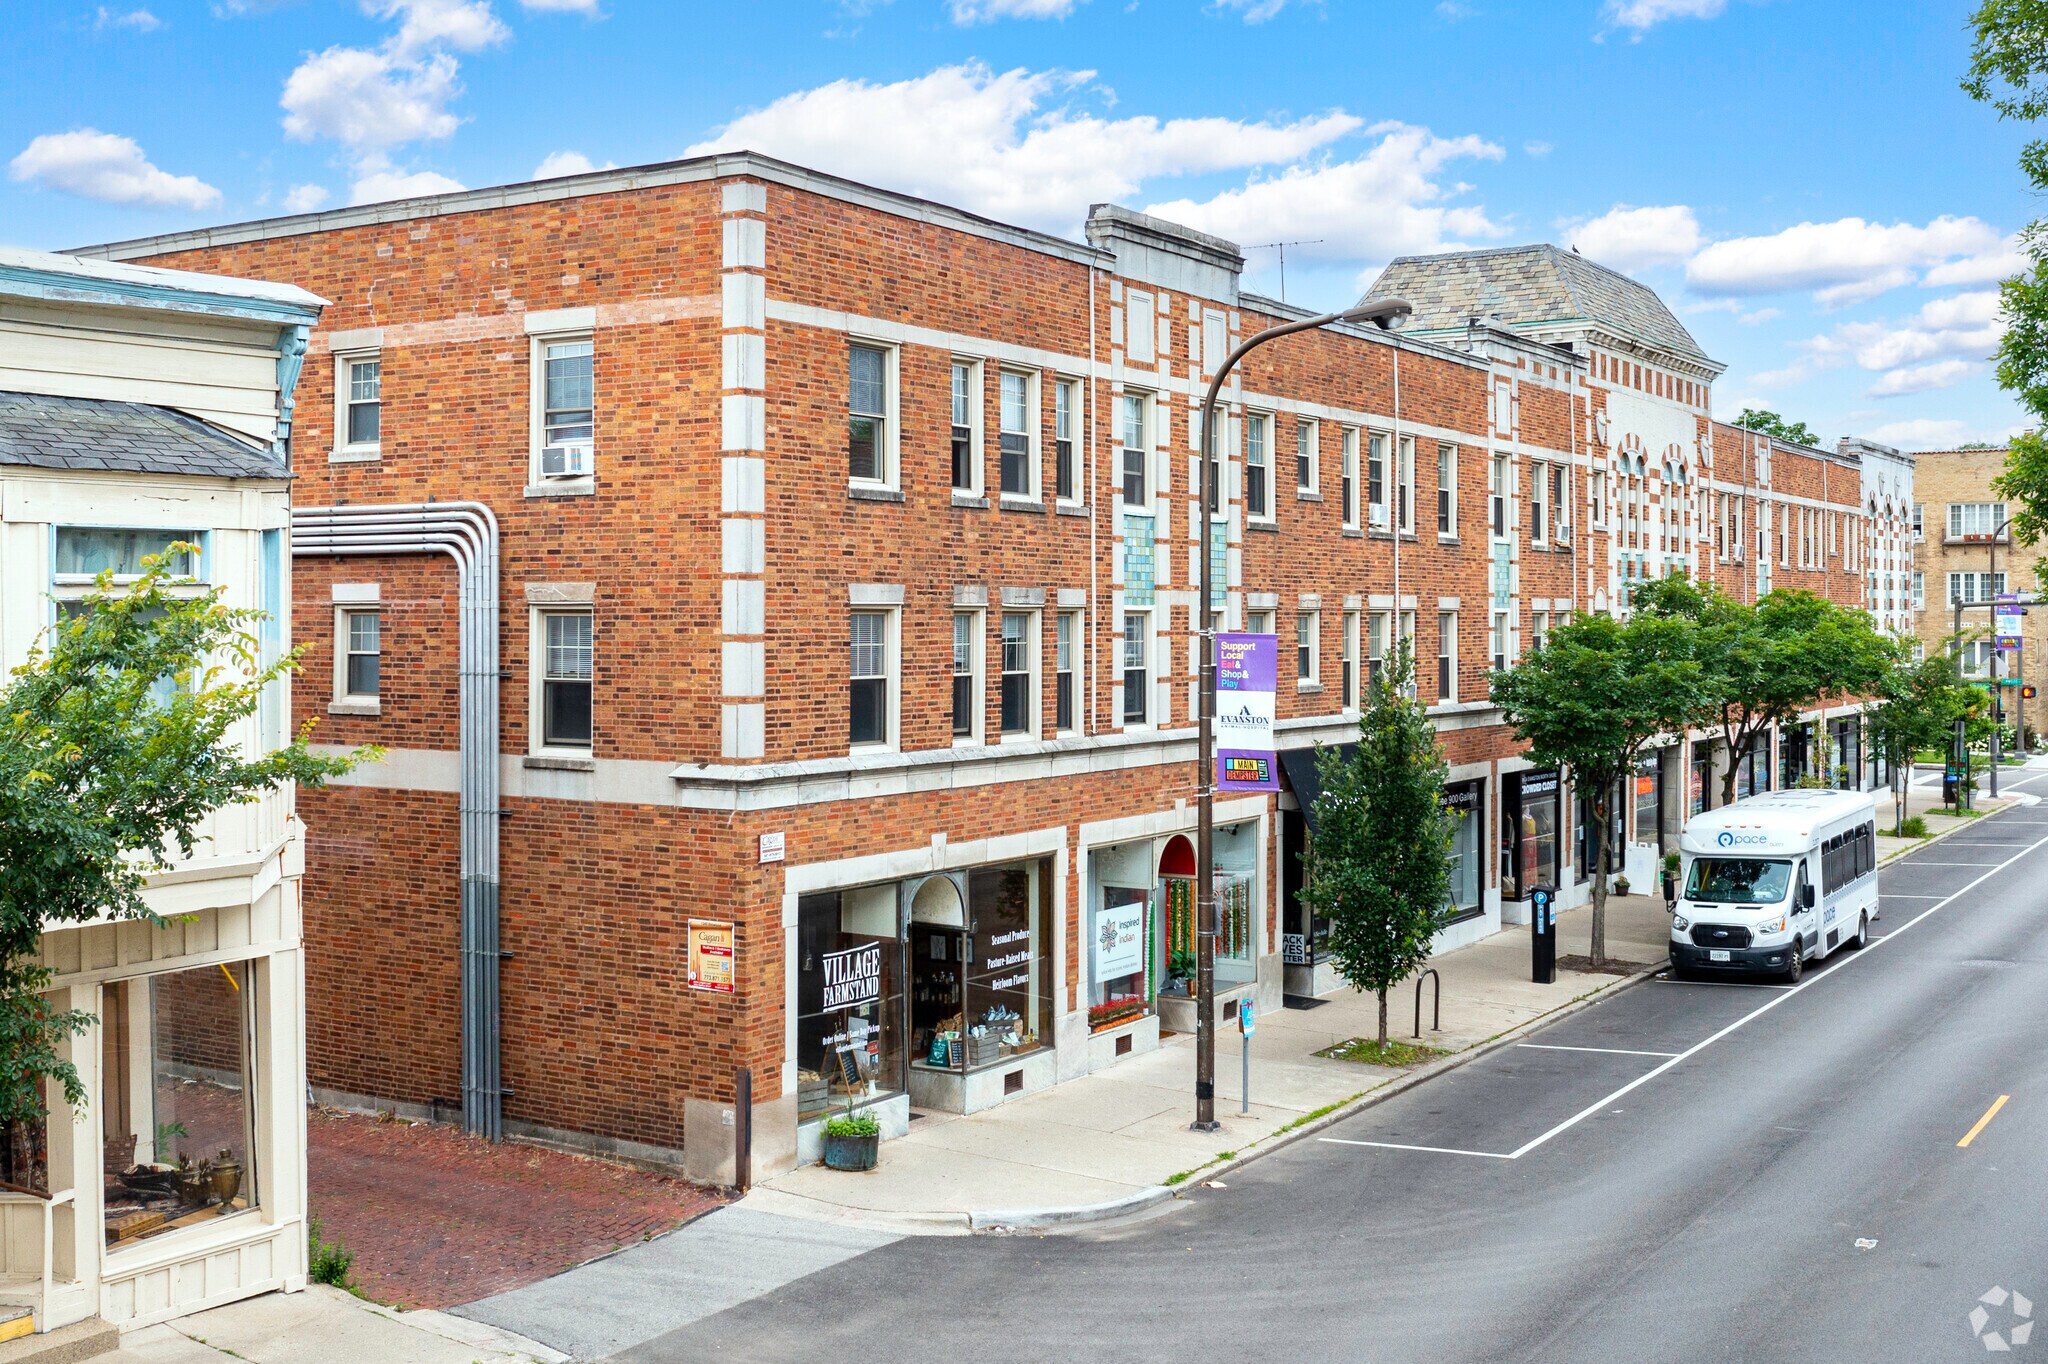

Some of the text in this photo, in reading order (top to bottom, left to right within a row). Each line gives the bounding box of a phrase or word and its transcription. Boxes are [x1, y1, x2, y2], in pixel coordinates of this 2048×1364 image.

[1221, 641, 1256, 652] Support
[1221, 651, 1244, 660] Local
[1221, 679, 1239, 689] Play
[1221, 715, 1270, 724] EVANSTON
[1237, 760, 1254, 769] MAIN
[1227, 771, 1259, 780] DEMPSTER
[1542, 780, 1558, 791] CLOSET
[1448, 794, 1459, 804] 900
[1459, 792, 1478, 802] Gallery
[1734, 836, 1767, 846] pace
[1119, 917, 1140, 930] inspired
[698, 931, 720, 943] Cagan
[991, 929, 1030, 946] Seasonal Produce
[1119, 933, 1136, 944] indian
[1283, 935, 1303, 945] ACK
[1283, 944, 1303, 955] VES
[987, 950, 1034, 970] Pasture-Raised Meats
[822, 949, 880, 986] VILLAGE
[992, 974, 1029, 991] Heirloom Flavors
[823, 976, 880, 1008] FARMSTAND
[822, 1035, 834, 1046] Order
[867, 1024, 880, 1034] Pickup
